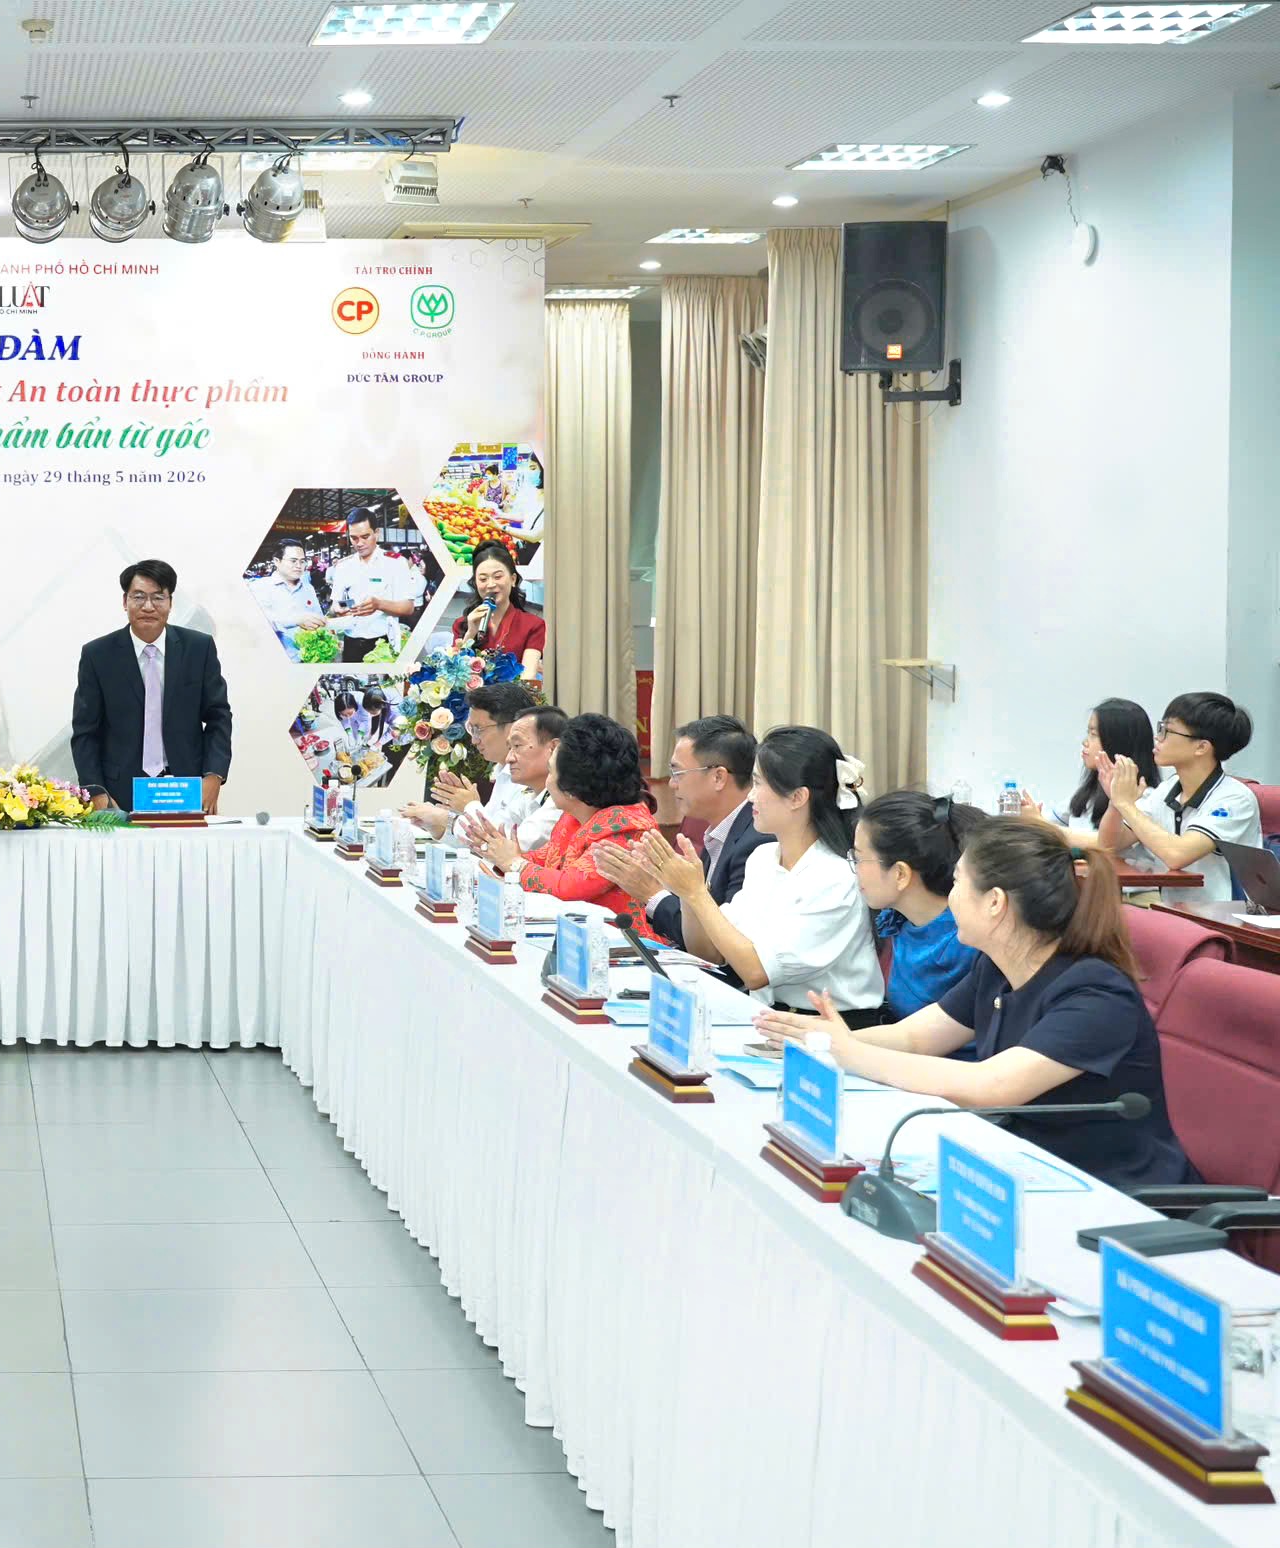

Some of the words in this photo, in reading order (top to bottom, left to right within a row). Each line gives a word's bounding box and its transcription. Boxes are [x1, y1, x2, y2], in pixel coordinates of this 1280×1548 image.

[121, 264, 159, 274] MINH
[337, 300, 374, 322] CP
[403, 374, 444, 383] GROUP
[8, 379, 47, 403] An
[56, 378, 121, 403] toàn
[131, 379, 198, 408] thực
[205, 375, 289, 409] phẩm
[55, 416, 115, 450] bẩn
[118, 420, 154, 450] từ
[154, 418, 211, 458] gốc
[4, 470, 39, 487] ngày
[44, 471, 62, 483] 29
[67, 470, 111, 487] tháng
[116, 471, 124, 483] 5
[129, 470, 162, 483] năm
[167, 471, 206, 483] 2026
